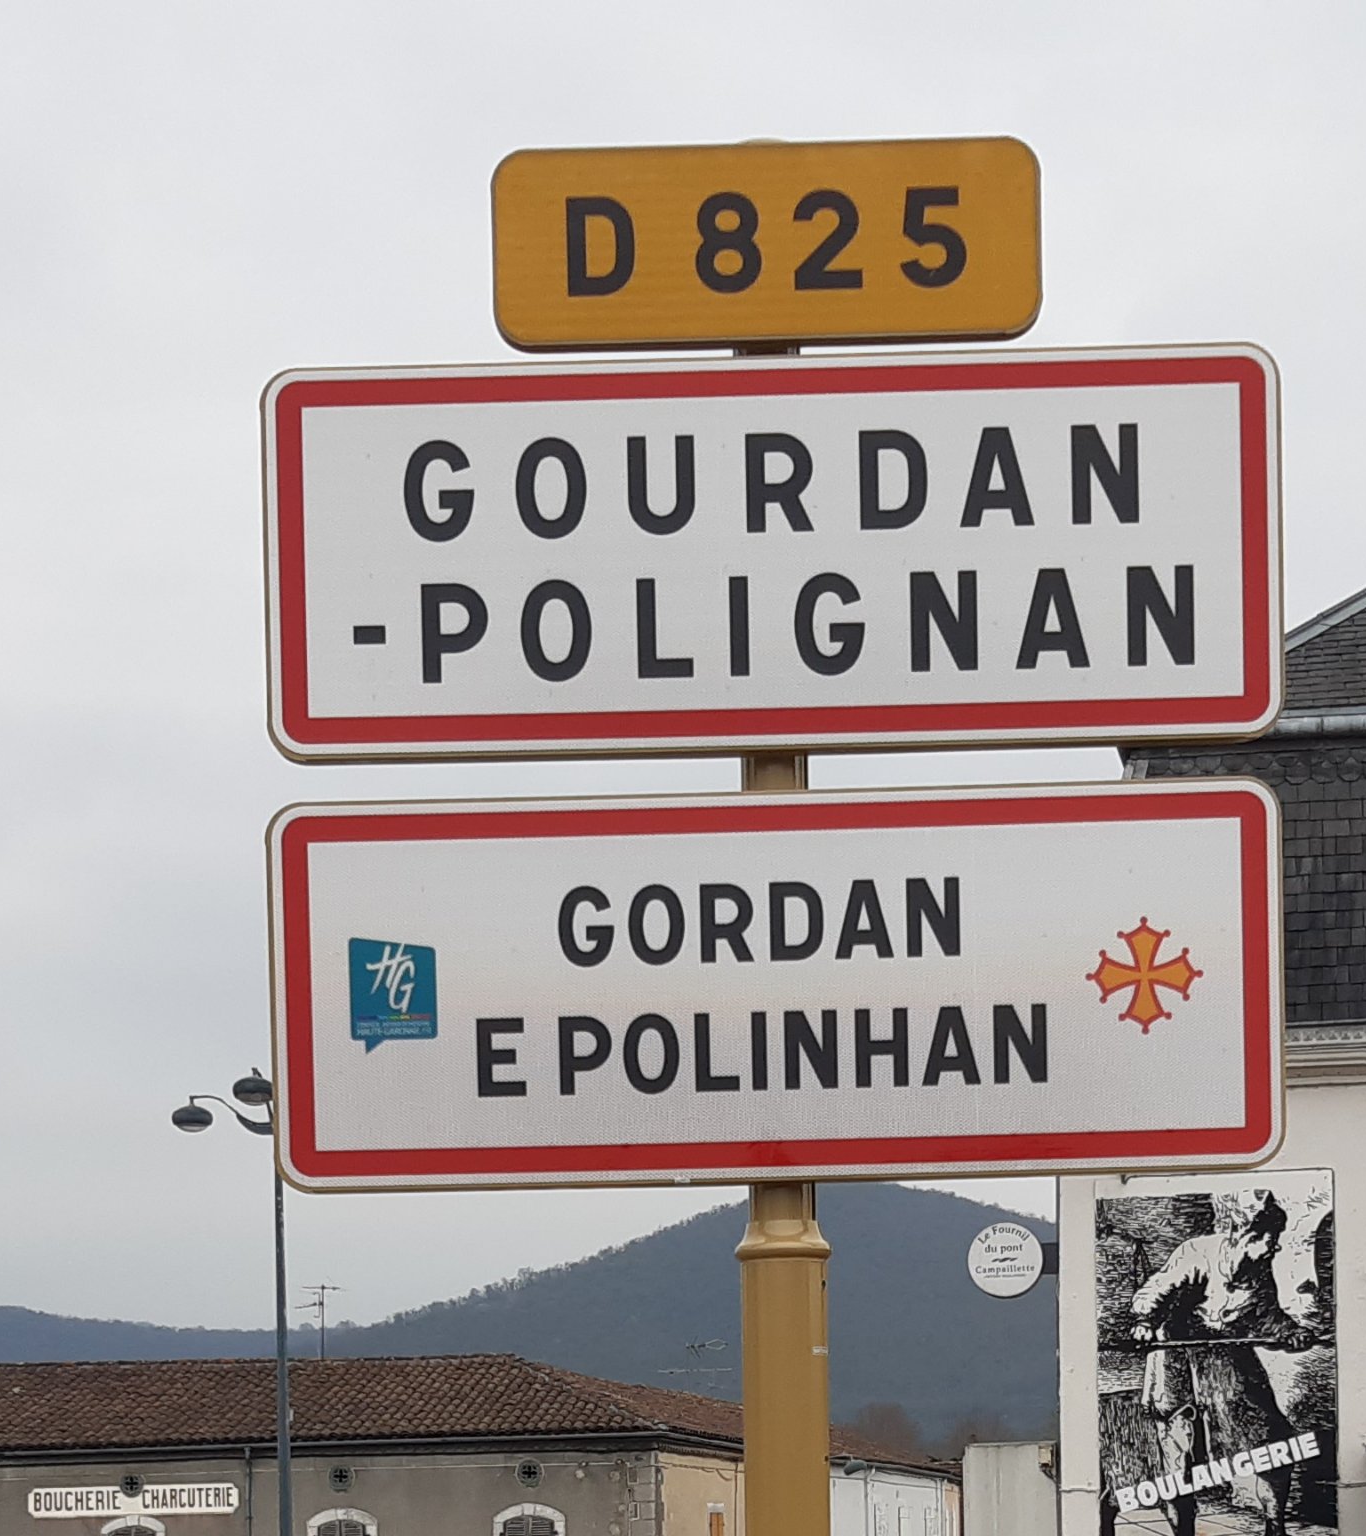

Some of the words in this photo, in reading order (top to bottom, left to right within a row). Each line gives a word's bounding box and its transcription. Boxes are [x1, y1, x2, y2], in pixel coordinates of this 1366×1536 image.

[565, 194, 635, 297] D
[695, 186, 968, 294] 825
[403, 423, 1140, 543] GOURDAN
[353, 564, 1196, 684] -POLIGNAN
[557, 876, 961, 968] GORDAN
[365, 943, 415, 1014] HG
[476, 1017, 528, 1098] E
[560, 1003, 1049, 1096] POLINHAN
[974, 1264, 1035, 1275] Campaillette
[977, 1232, 991, 1245] Le
[991, 1225, 1031, 1242] Fournil
[984, 1244, 997, 1253] du
[1000, 1243, 1023, 1255] pont
[33, 1490, 122, 1512] BOUCHERIE
[142, 1486, 235, 1509] CHARCUTERIE
[1116, 1431, 1321, 1514] BOULANGERIE
